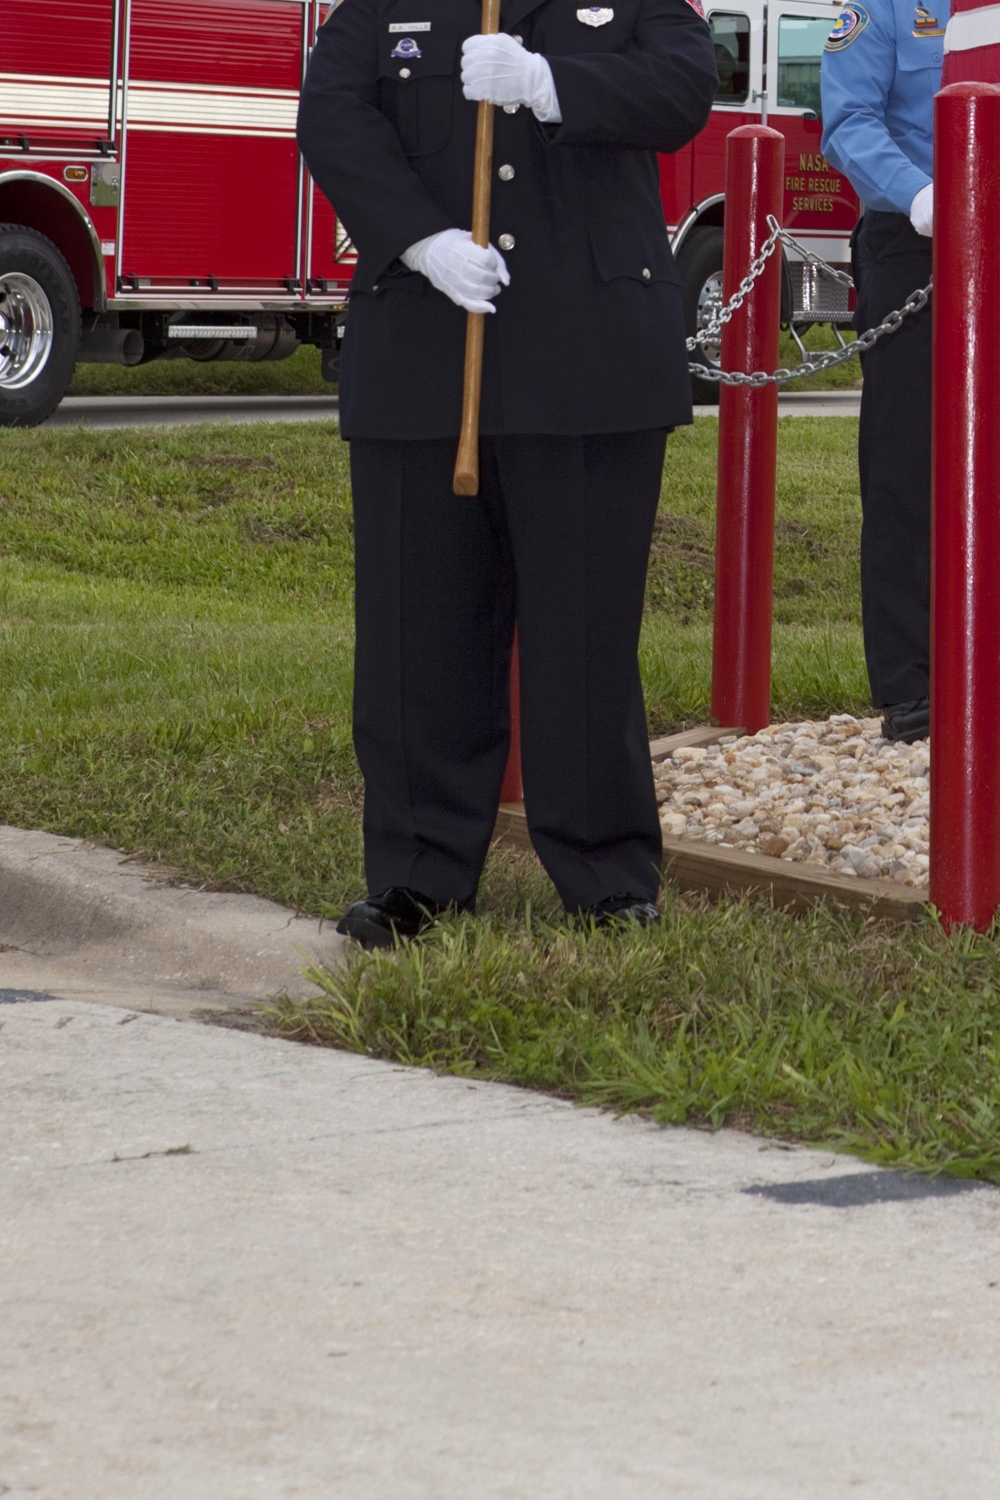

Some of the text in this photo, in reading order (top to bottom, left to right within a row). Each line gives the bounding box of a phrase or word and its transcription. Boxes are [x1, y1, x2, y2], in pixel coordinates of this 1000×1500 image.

[800, 153, 829, 172] NASA
[785, 177, 841, 193] FIRE RESCUE
[792, 197, 833, 212] SERVICES
